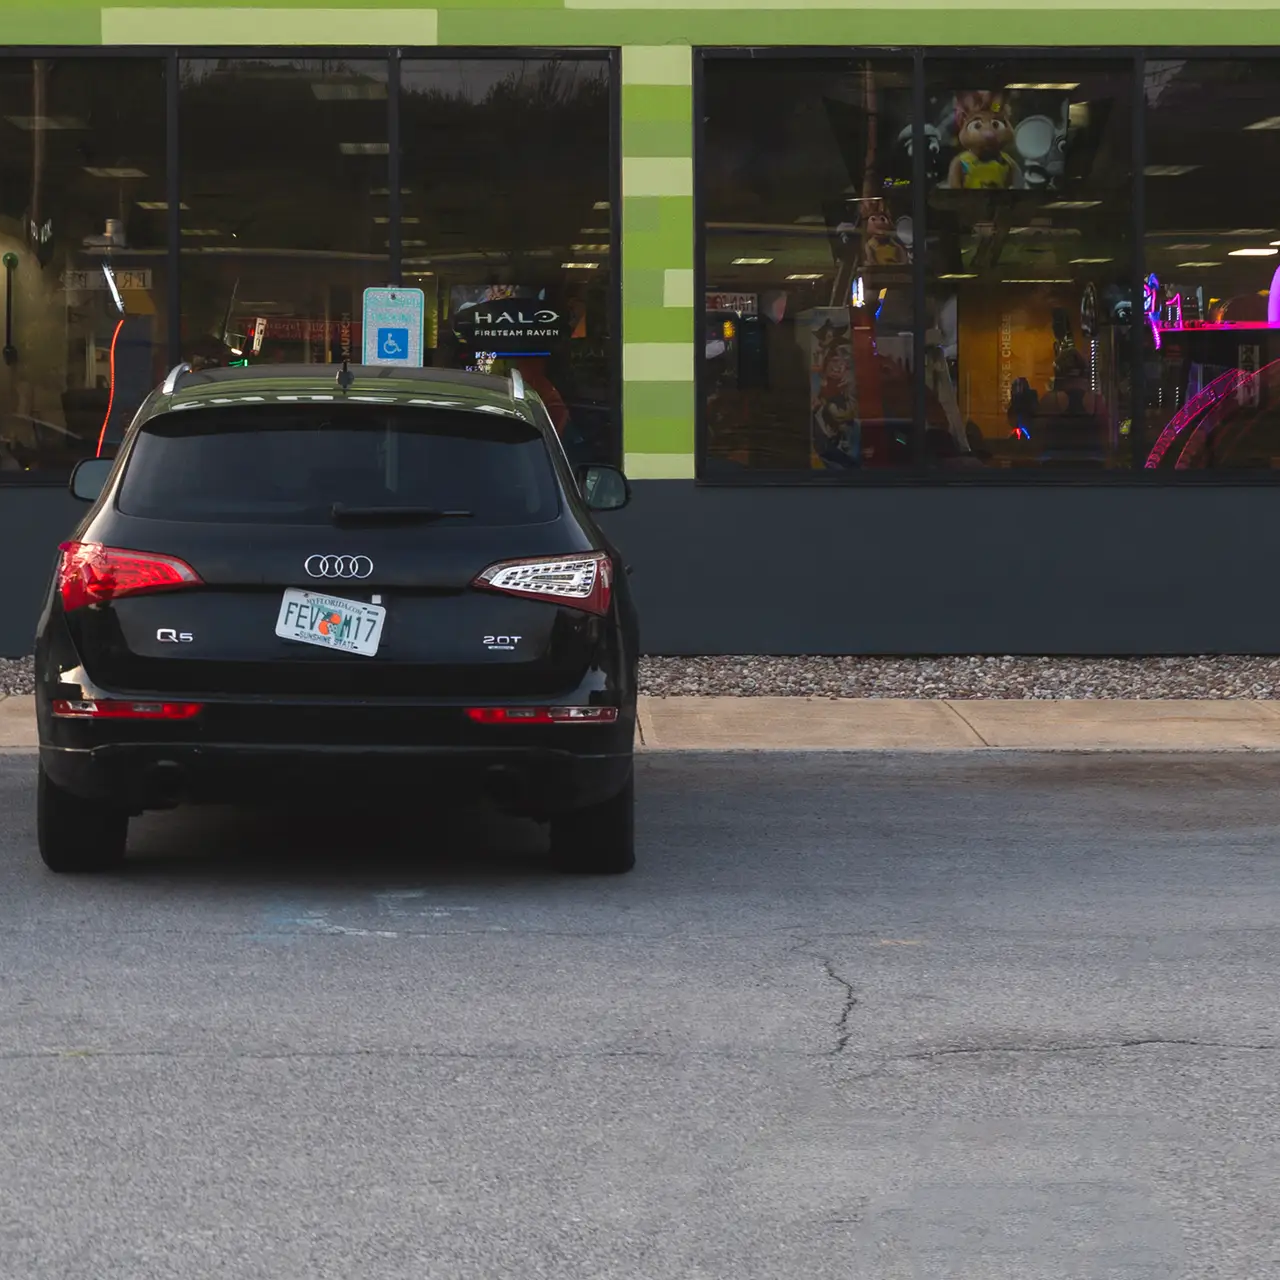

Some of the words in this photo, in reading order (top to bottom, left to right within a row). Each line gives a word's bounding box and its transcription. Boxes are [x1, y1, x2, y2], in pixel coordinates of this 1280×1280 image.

[474, 309, 560, 324] HALO
[474, 329, 523, 337] FIRETEAM
[284, 601, 320, 631] FEV
[340, 614, 377, 643] M17
[156, 628, 194, 643] Q5
[299, 630, 332, 645] SUNSHINE
[333, 638, 355, 650] STATE
